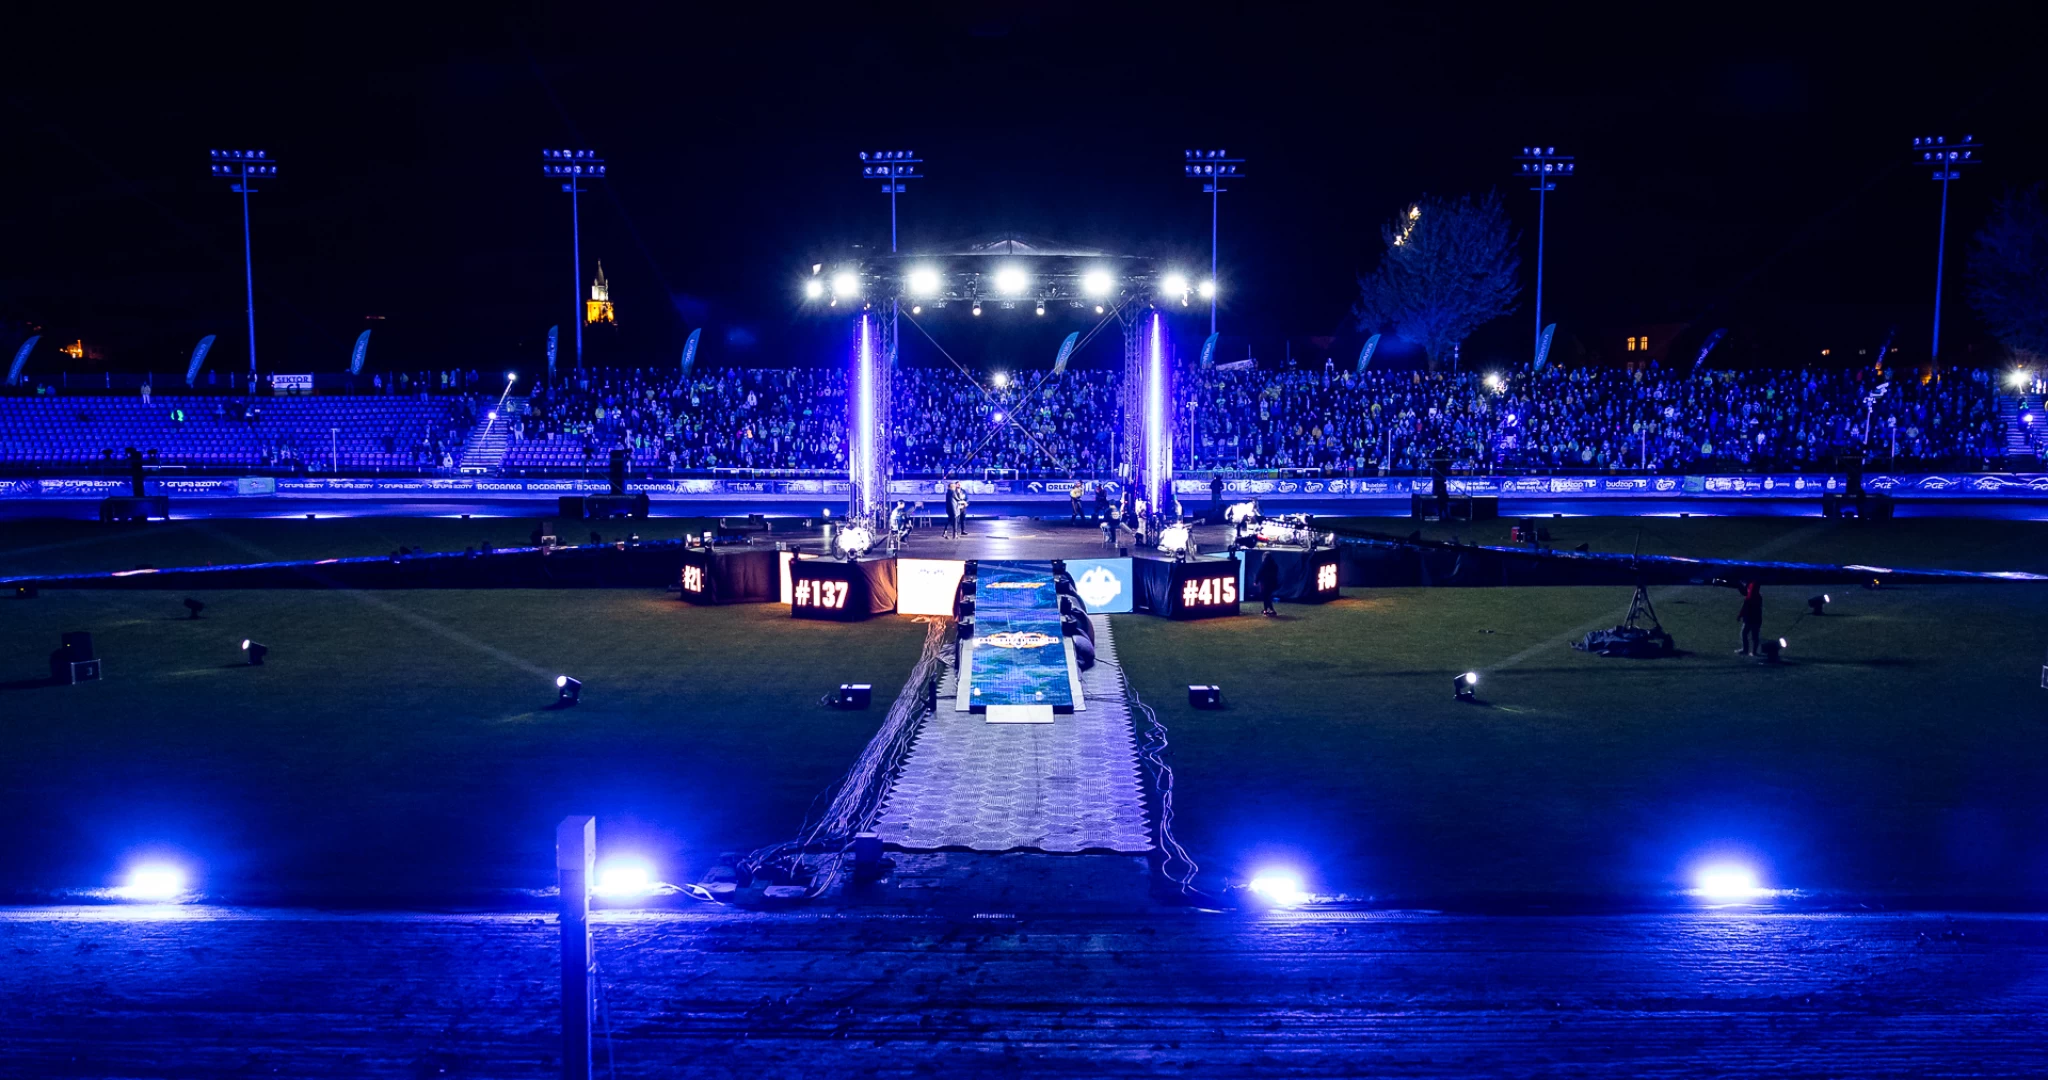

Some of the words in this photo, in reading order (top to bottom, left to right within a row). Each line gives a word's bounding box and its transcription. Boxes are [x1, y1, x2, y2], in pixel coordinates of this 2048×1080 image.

[684, 565, 702, 593] #21
[1183, 577, 1236, 607] #415
[795, 581, 848, 609] #137
